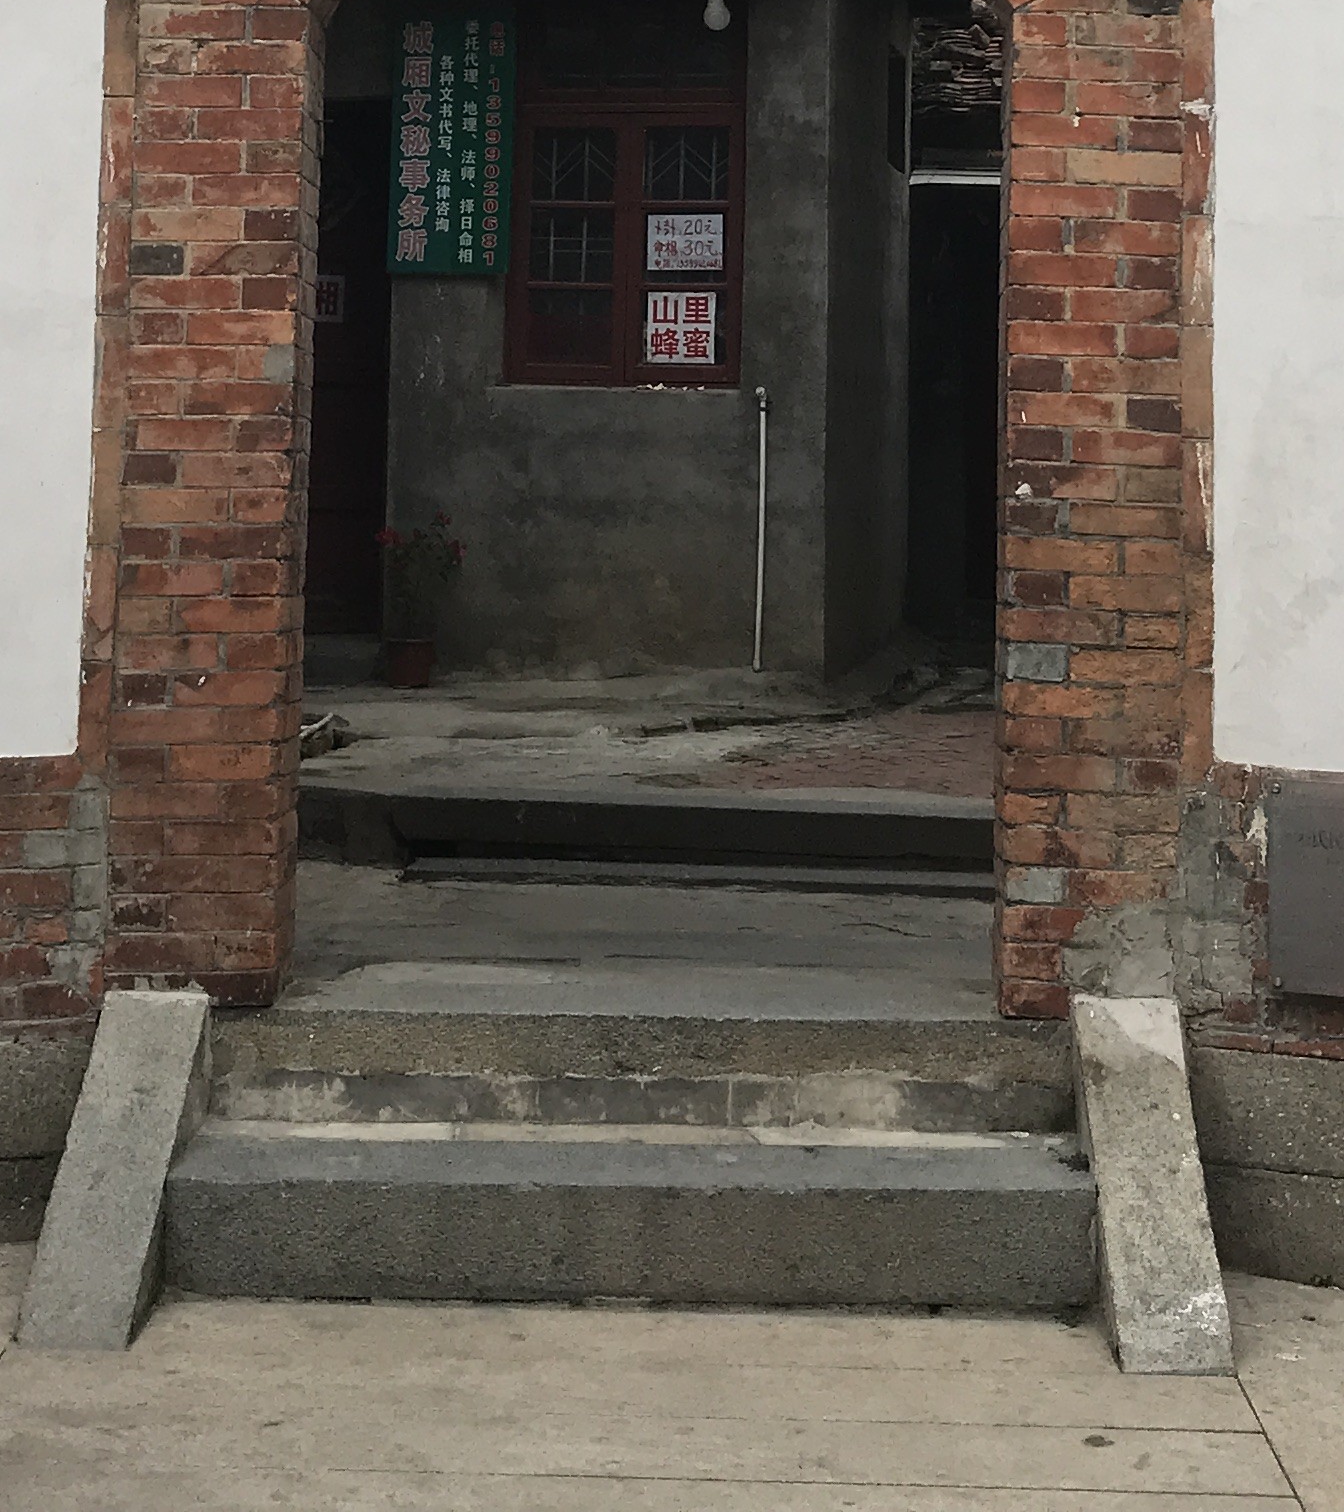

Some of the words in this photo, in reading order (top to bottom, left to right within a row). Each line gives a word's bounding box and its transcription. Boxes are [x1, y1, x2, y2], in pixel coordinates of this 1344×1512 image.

[395, 20, 434, 262] 城厢文秘事务所
[652, 296, 711, 325] 山里
[651, 327, 710, 359] 蜂蜜
